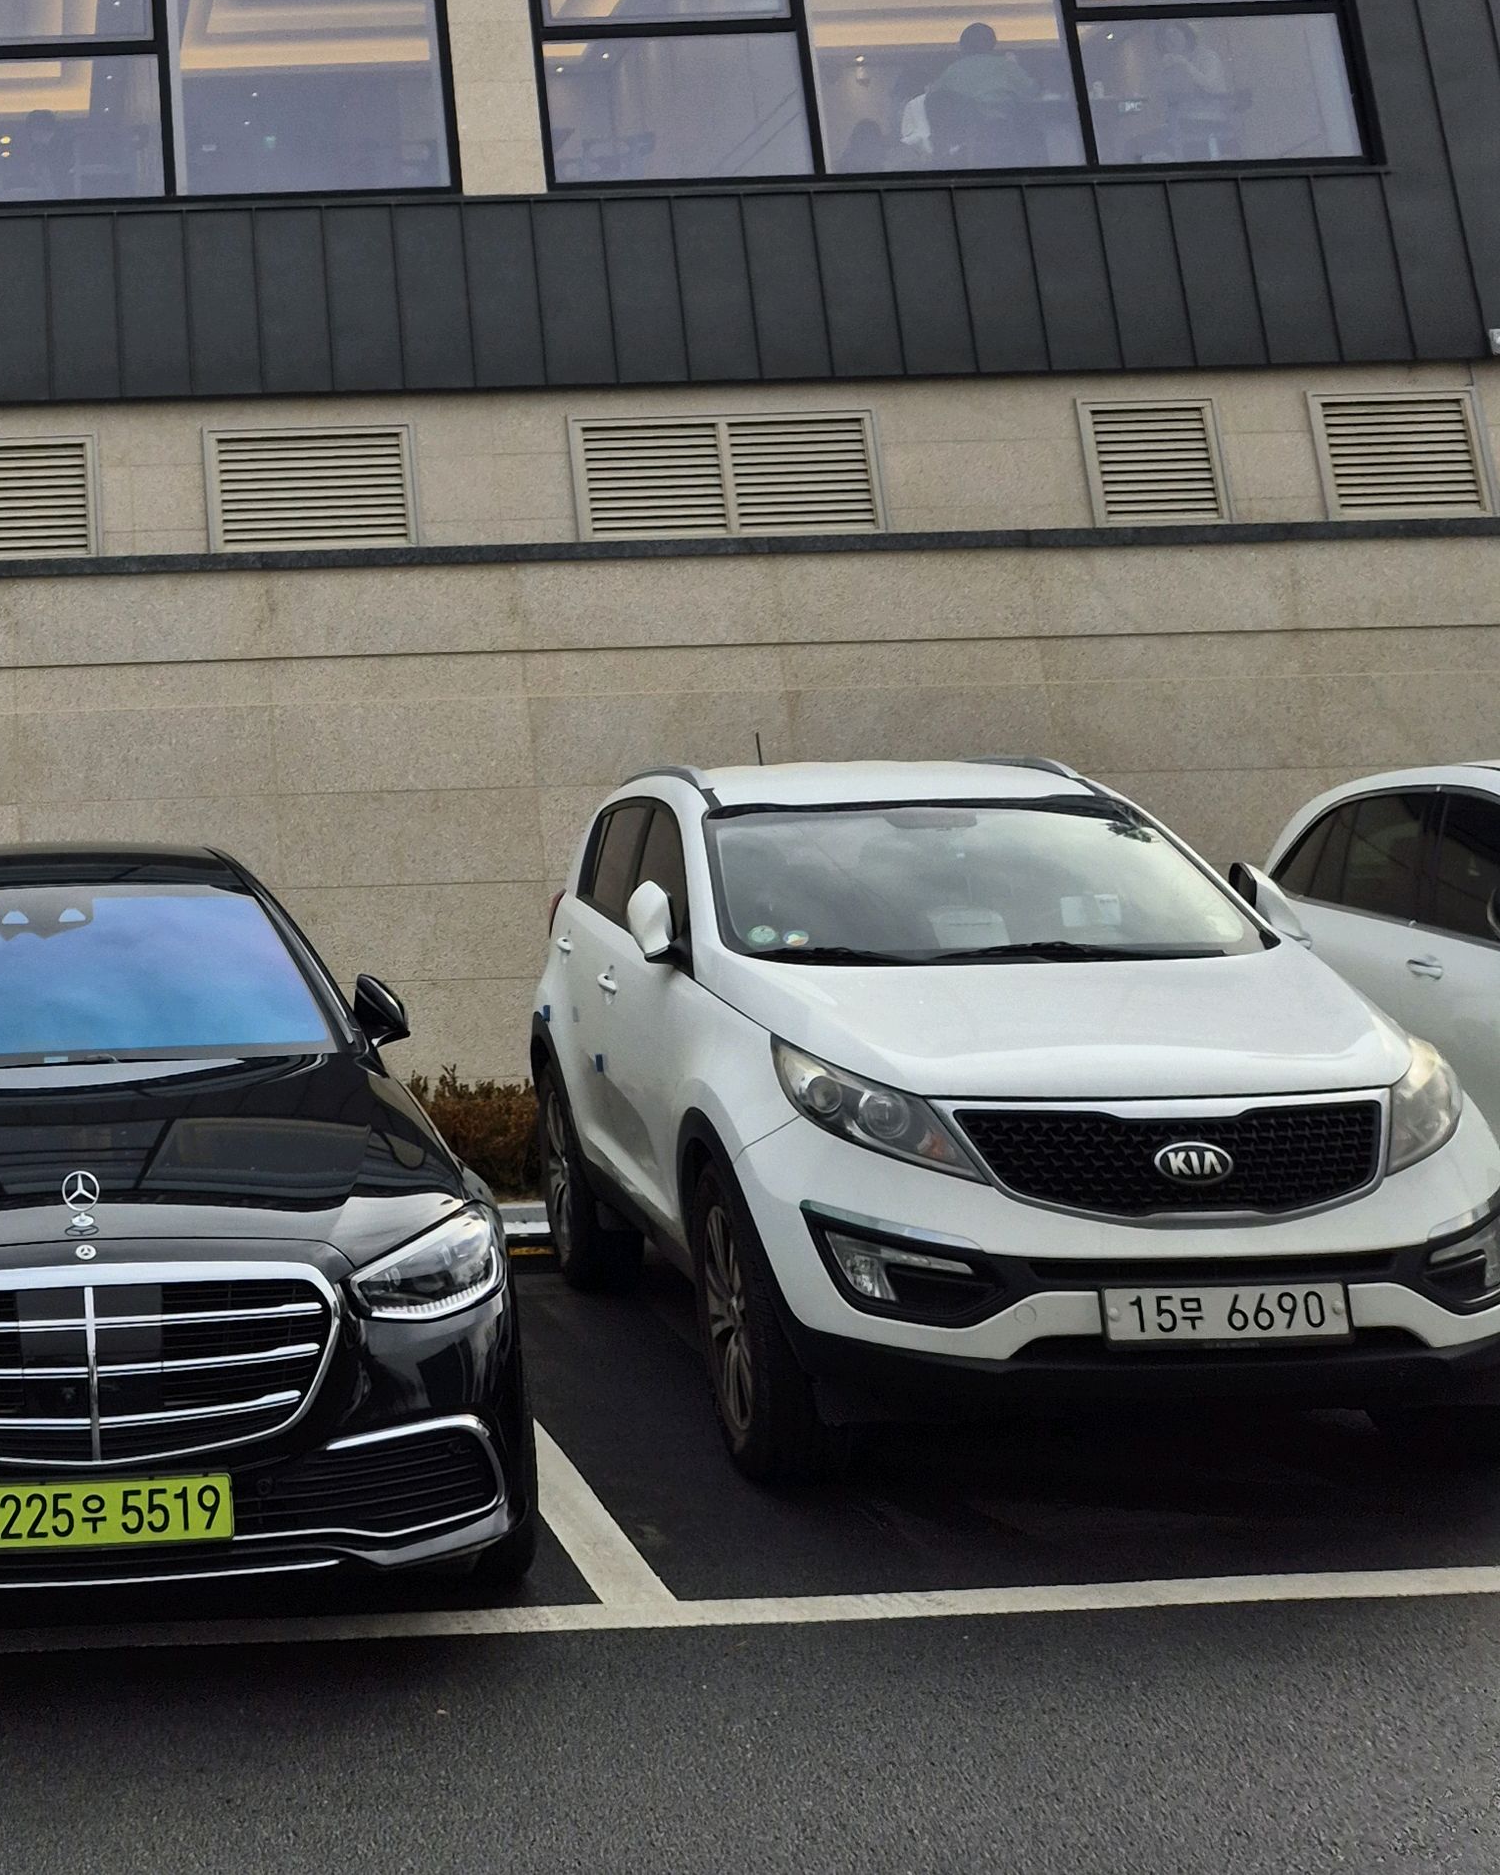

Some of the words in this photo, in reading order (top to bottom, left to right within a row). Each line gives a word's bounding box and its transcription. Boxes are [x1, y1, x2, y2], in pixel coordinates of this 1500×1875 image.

[1166, 1150, 1223, 1175] KIA
[1128, 1294, 1204, 1333] 15무
[1226, 1290, 1326, 1332] 6690
[0, 1492, 107, 1540] 225우
[120, 1484, 221, 1535] 5519
